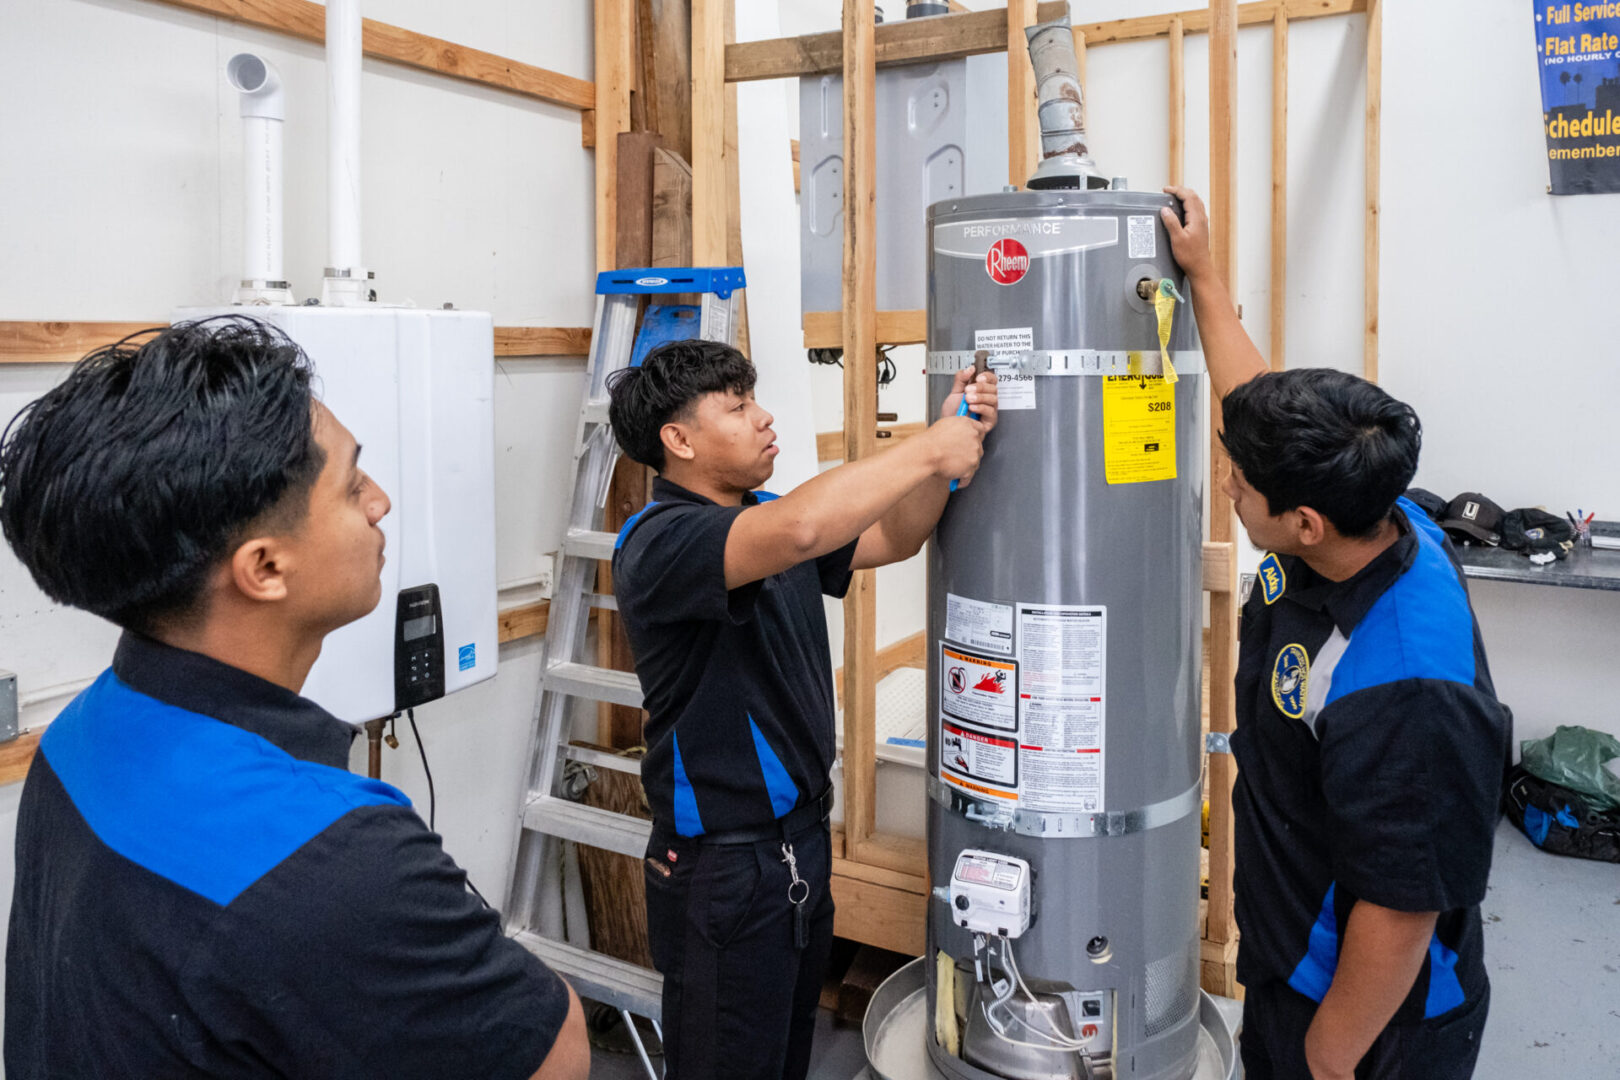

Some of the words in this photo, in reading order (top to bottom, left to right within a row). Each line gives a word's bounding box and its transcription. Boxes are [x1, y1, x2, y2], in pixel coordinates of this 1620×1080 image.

[1547, 4, 1571, 25] Full
[1574, 0, 1620, 22] Service
[1546, 36, 1575, 56] Flat
[1581, 32, 1618, 53] Rate
[1544, 56, 1564, 66] (NO
[1567, 52, 1612, 63] HOURLY
[964, 222, 1061, 237] PERFORMANCE
[991, 239, 1027, 277] Rheem
[1466, 502, 1477, 516] U
[965, 656, 991, 667] WARNING
[965, 732, 988, 743] DANGER
